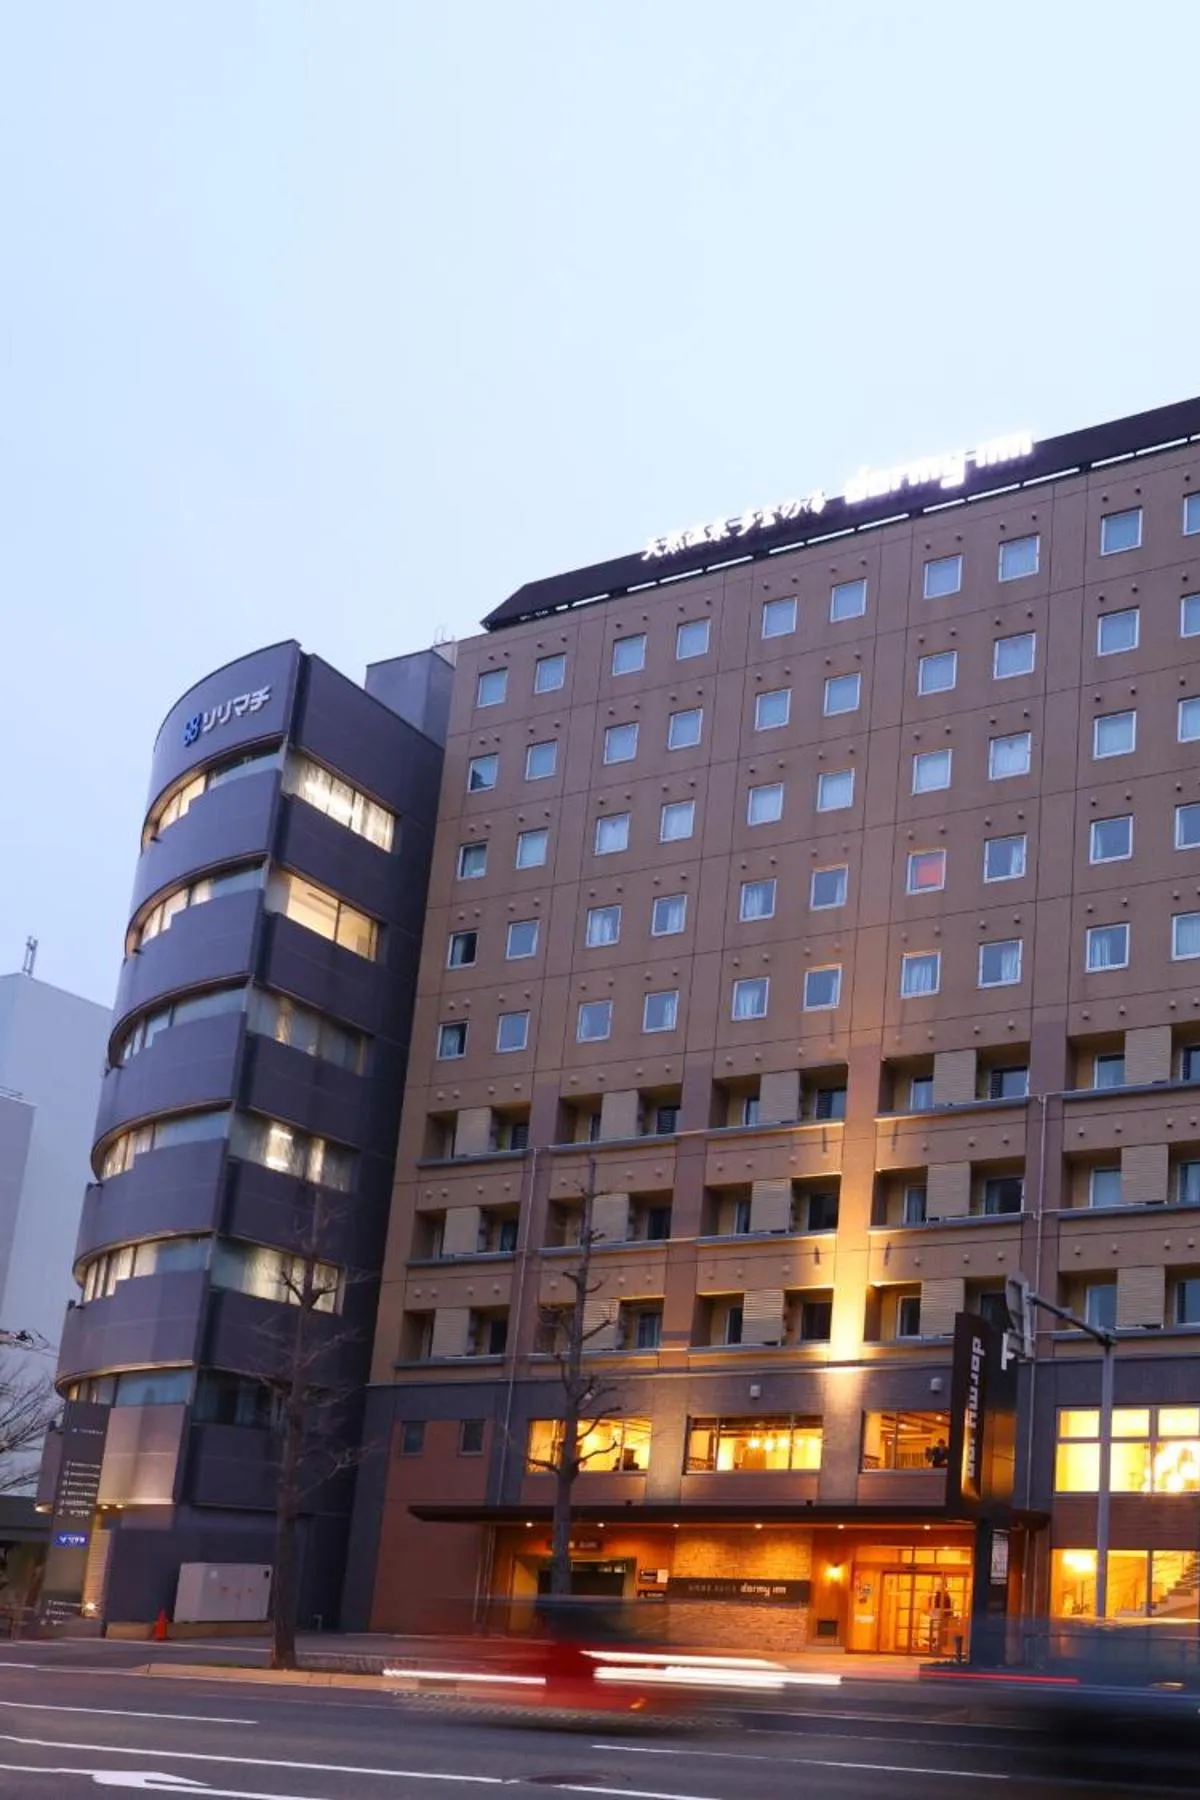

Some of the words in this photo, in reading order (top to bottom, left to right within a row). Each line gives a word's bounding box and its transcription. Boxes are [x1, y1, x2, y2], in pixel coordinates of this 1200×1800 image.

[202, 685, 271, 733] リリマチ
[964, 1335, 986, 1429] dormy
